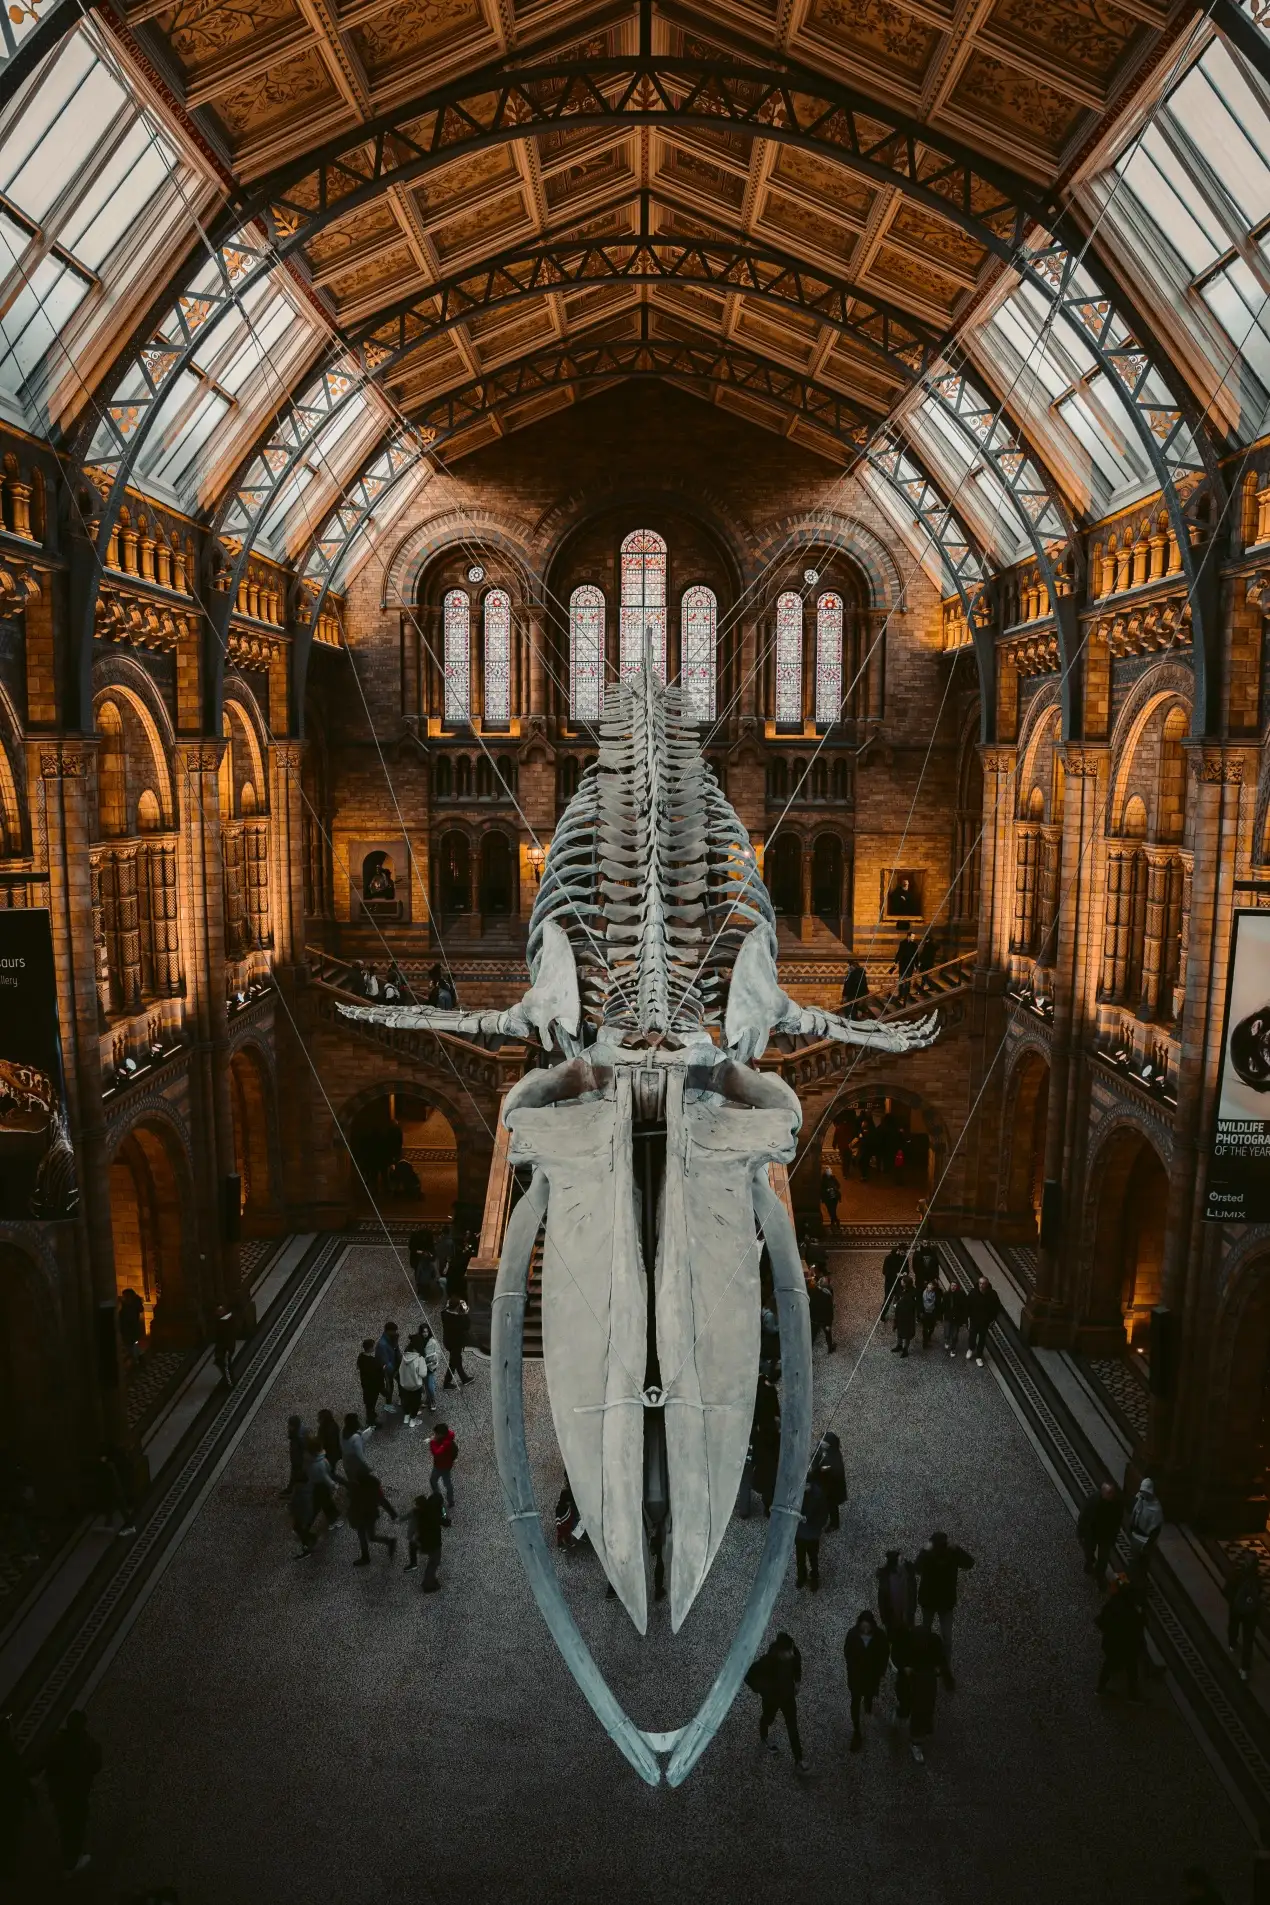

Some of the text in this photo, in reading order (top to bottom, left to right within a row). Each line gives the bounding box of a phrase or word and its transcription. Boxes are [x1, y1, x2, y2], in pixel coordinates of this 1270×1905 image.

[1218, 1121, 1264, 1132] WILDLIFE
[1214, 1146, 1270, 1157] OF THE YEAR
